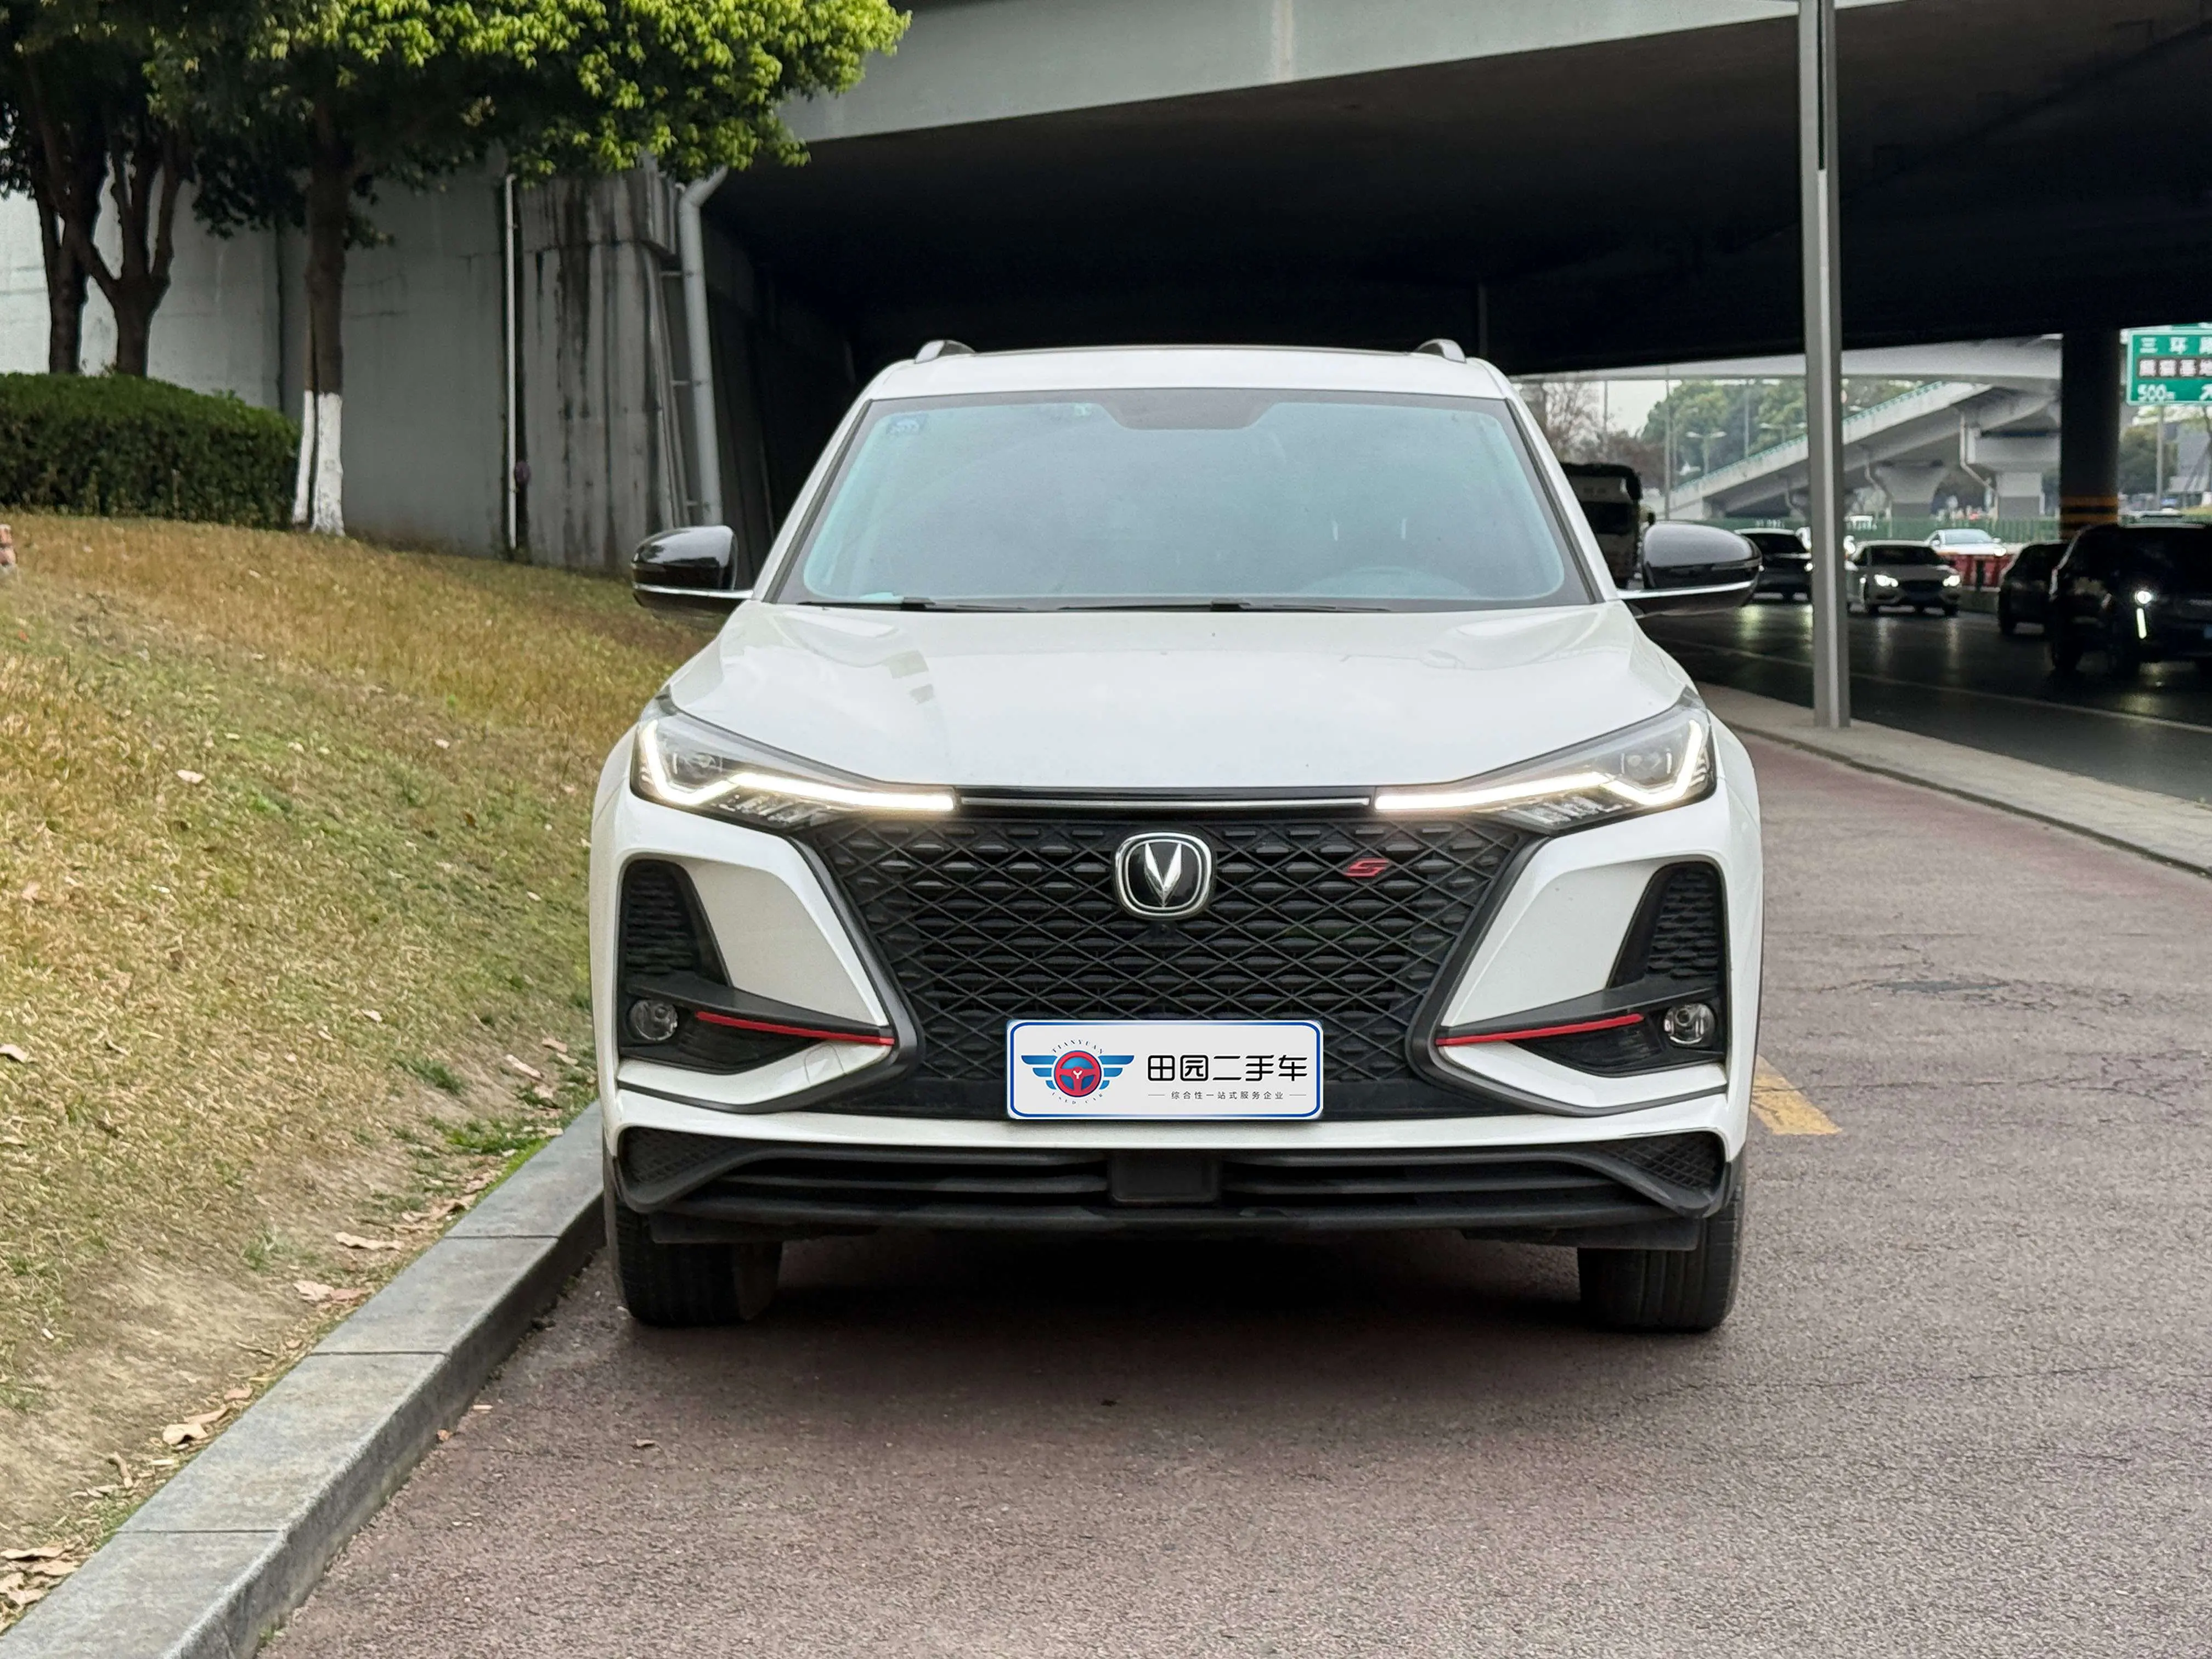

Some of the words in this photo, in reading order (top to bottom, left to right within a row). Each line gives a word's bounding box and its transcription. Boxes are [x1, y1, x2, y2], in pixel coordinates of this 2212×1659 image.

[1148, 1054, 1308, 1081] 田园二手车
[1171, 1091, 1283, 1099] 综合性一站式服务企业
